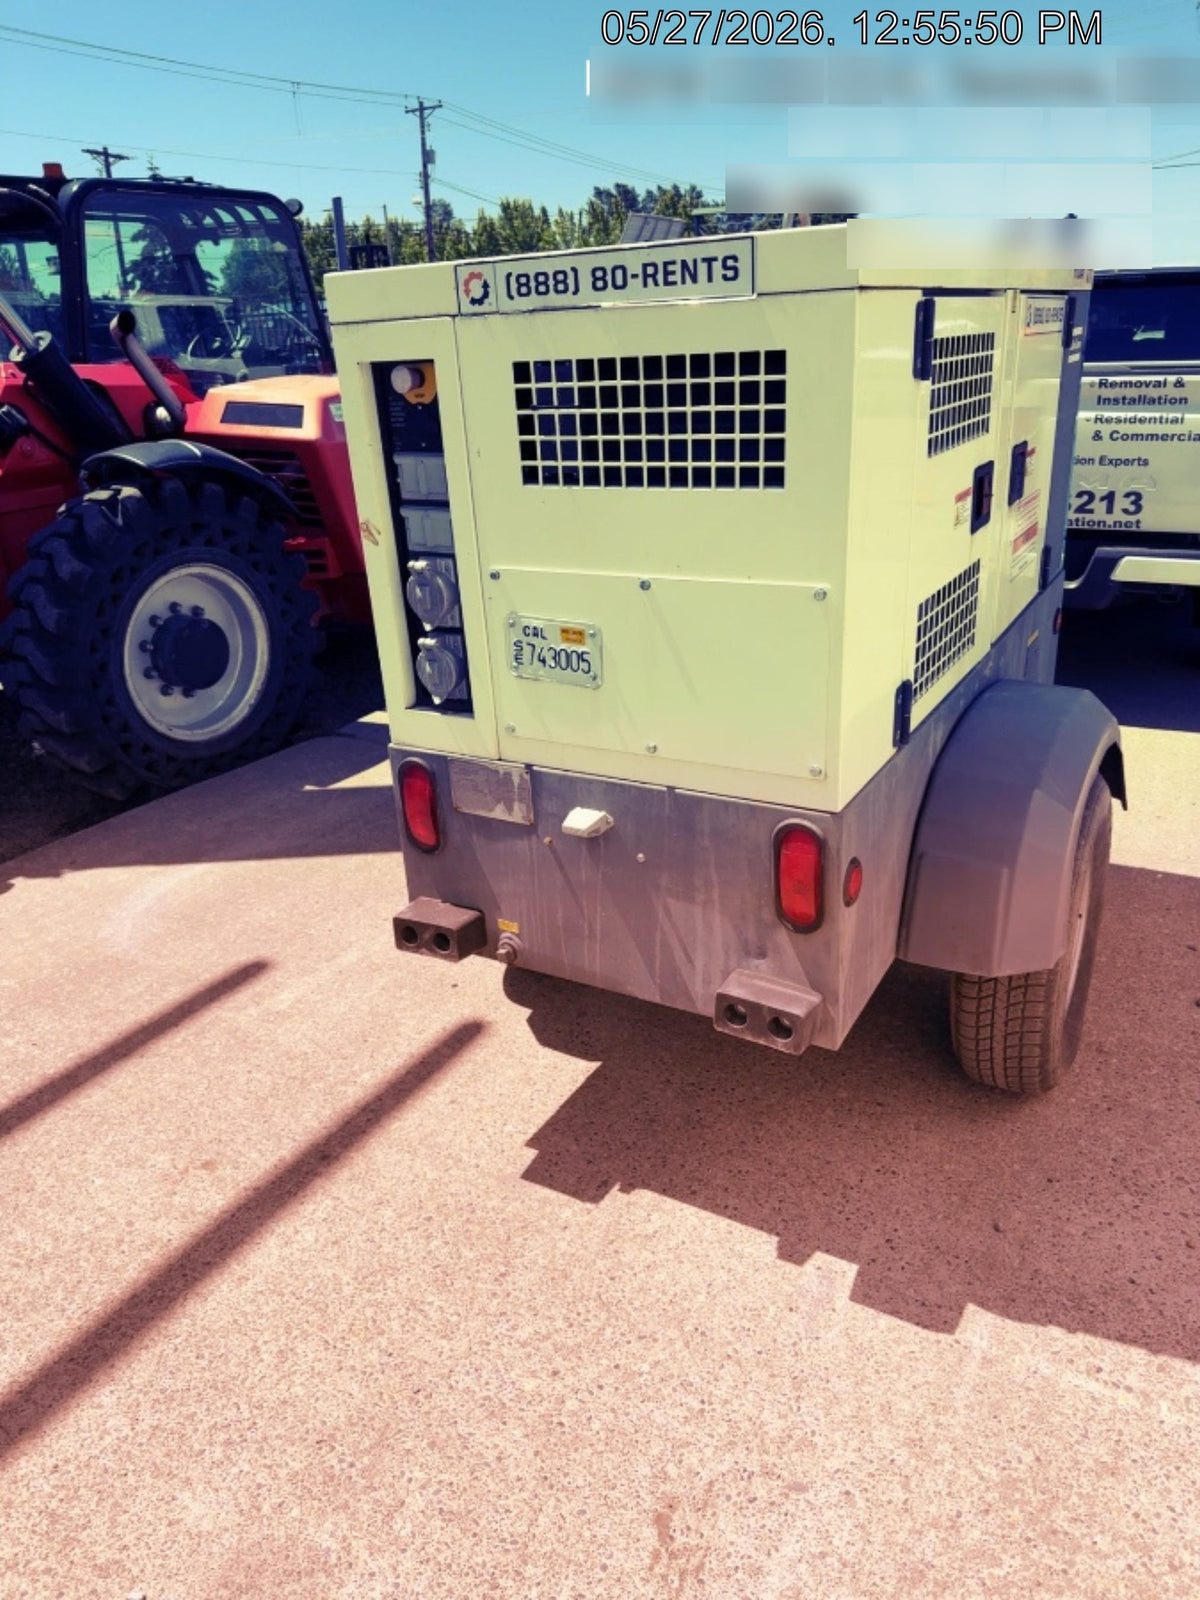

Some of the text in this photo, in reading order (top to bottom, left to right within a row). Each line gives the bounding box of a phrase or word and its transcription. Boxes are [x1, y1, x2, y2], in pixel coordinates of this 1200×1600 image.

[505, 254, 740, 301] (888) 80-RENTS
[1173, 376, 1186, 389] &
[1096, 395, 1189, 406] Installation
[1091, 430, 1104, 442] &
[1073, 454, 1150, 469] ion Experts
[1068, 490, 1144, 517] 213
[522, 625, 548, 641] CAL
[526, 642, 592, 675] 743005
